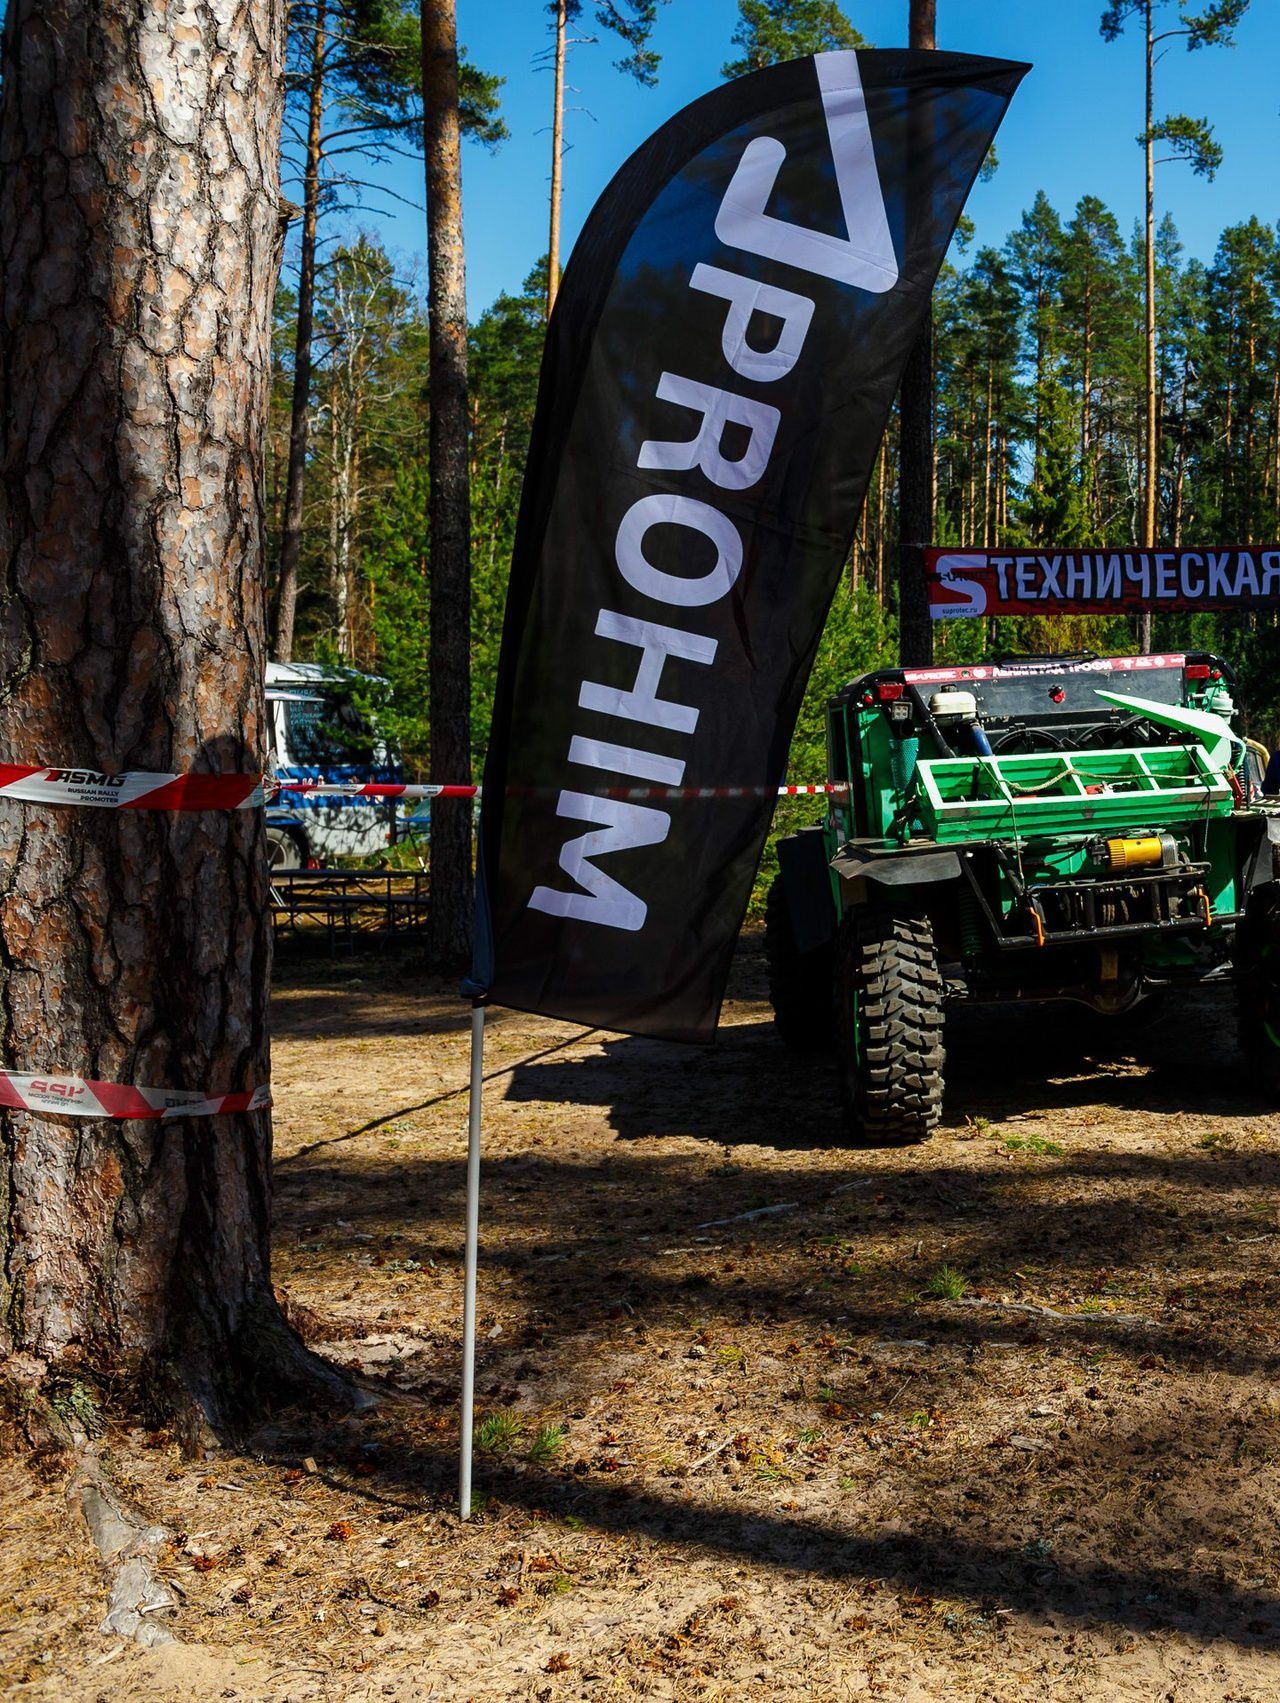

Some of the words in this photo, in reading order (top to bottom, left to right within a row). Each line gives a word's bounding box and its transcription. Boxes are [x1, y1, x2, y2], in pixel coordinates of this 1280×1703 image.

[942, 607, 978, 615] suprotec.ru
[53, 769, 127, 787] ASMG
[68, 788, 97, 796] RUSSIAN
